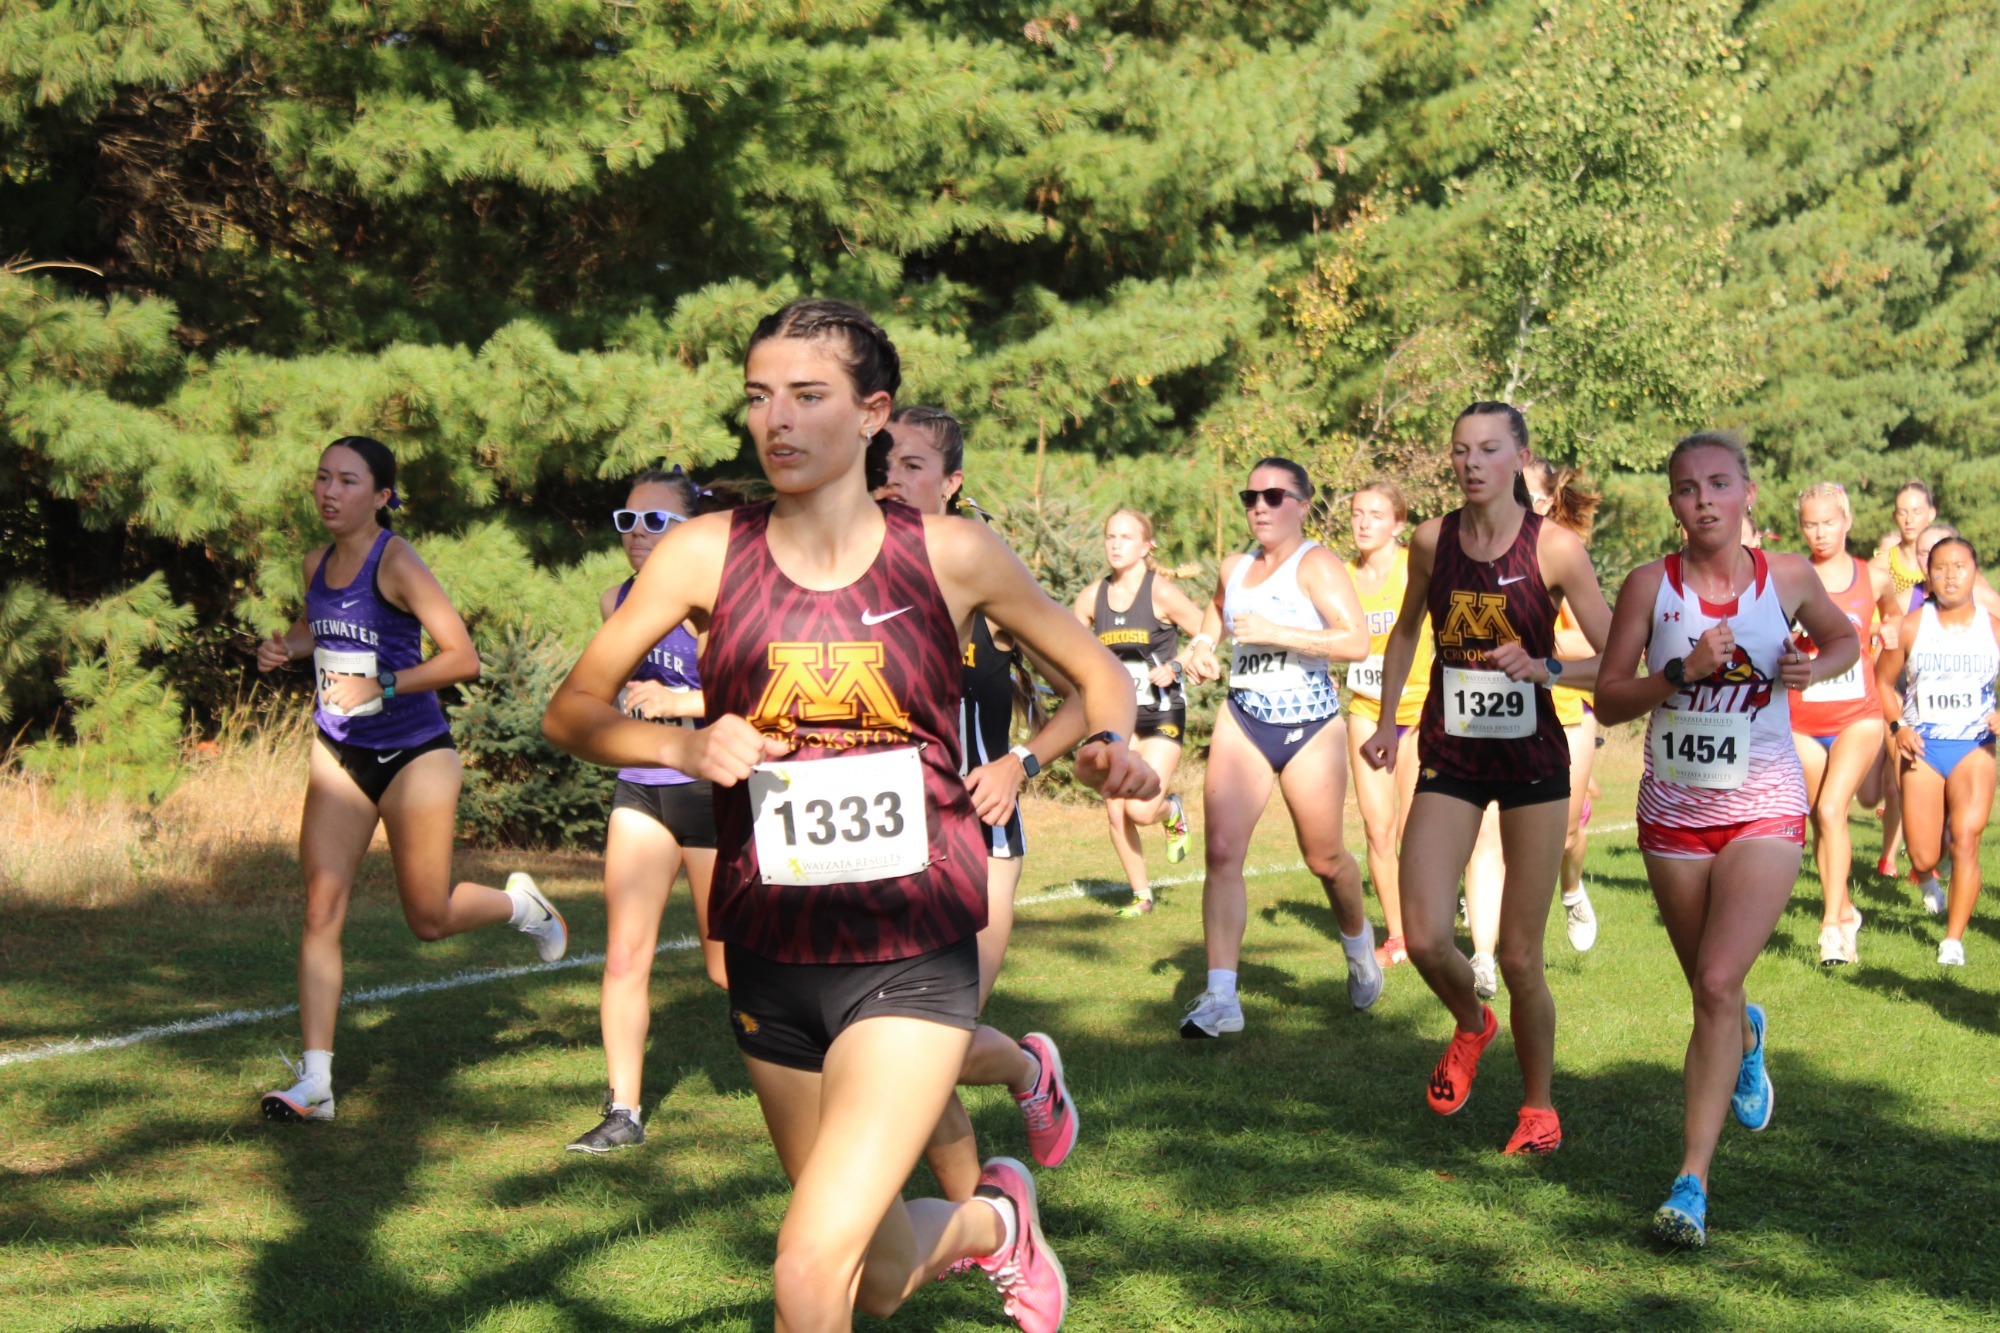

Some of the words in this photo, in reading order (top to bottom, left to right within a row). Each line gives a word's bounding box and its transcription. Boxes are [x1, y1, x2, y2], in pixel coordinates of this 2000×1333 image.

[1365, 611, 1394, 634] SP
[1238, 651, 1288, 675] 2027
[1916, 652, 1994, 674] CONCORDIA
[746, 642, 912, 732] M
[1454, 690, 1524, 717] 1329
[1926, 693, 1972, 710] 1063
[1662, 731, 1737, 764] 1454
[773, 791, 905, 846] 1333
[803, 859, 851, 872] WAYZATA
[855, 853, 902, 868] RESULTS
